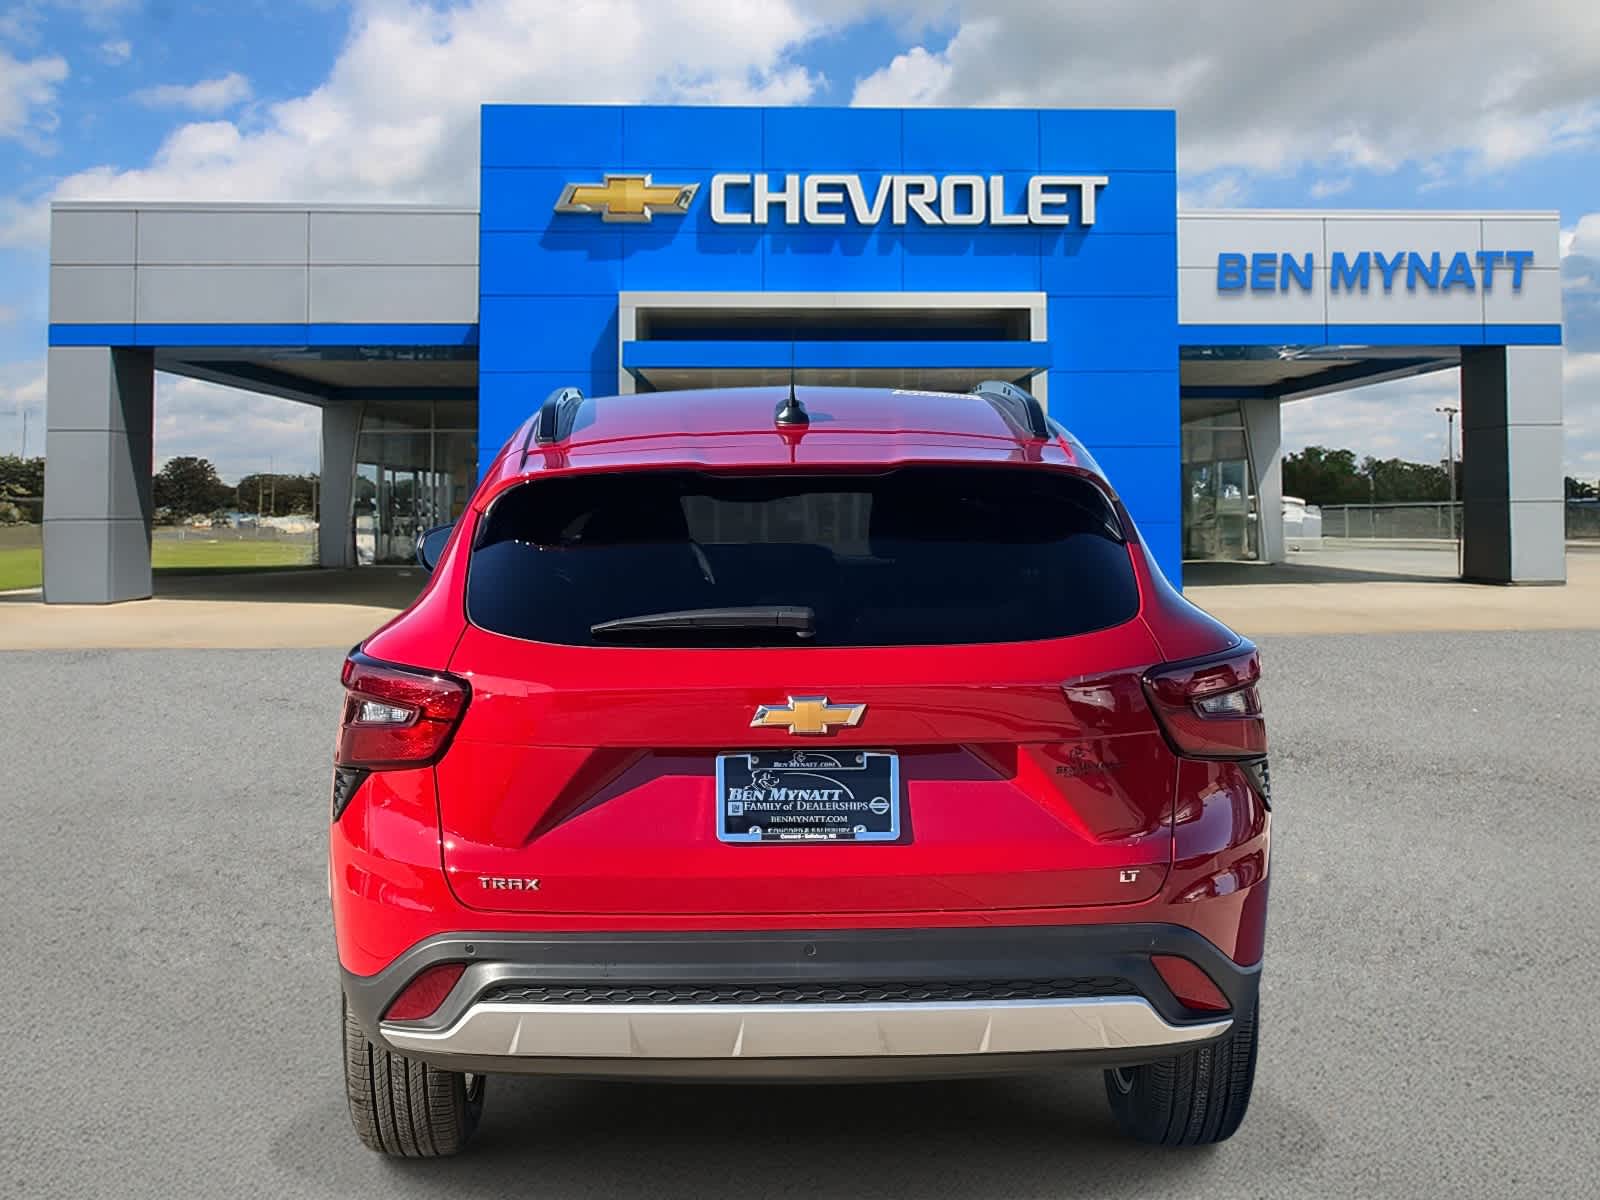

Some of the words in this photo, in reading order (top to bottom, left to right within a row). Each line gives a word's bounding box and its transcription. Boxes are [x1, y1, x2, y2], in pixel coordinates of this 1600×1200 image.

[711, 174, 1109, 225] CHEVROLET
[1217, 252, 1314, 291] BEN
[1330, 250, 1534, 291] MYNATT
[728, 788, 766, 801] BEN
[769, 788, 844, 801] MYNATT
[743, 802, 782, 811] FAMILY
[783, 802, 793, 811] of
[797, 801, 869, 811] DEALERSHIPS
[770, 815, 848, 823] BENMYNATT.COM
[1119, 870, 1140, 882] LT
[477, 876, 540, 890] TRAX
